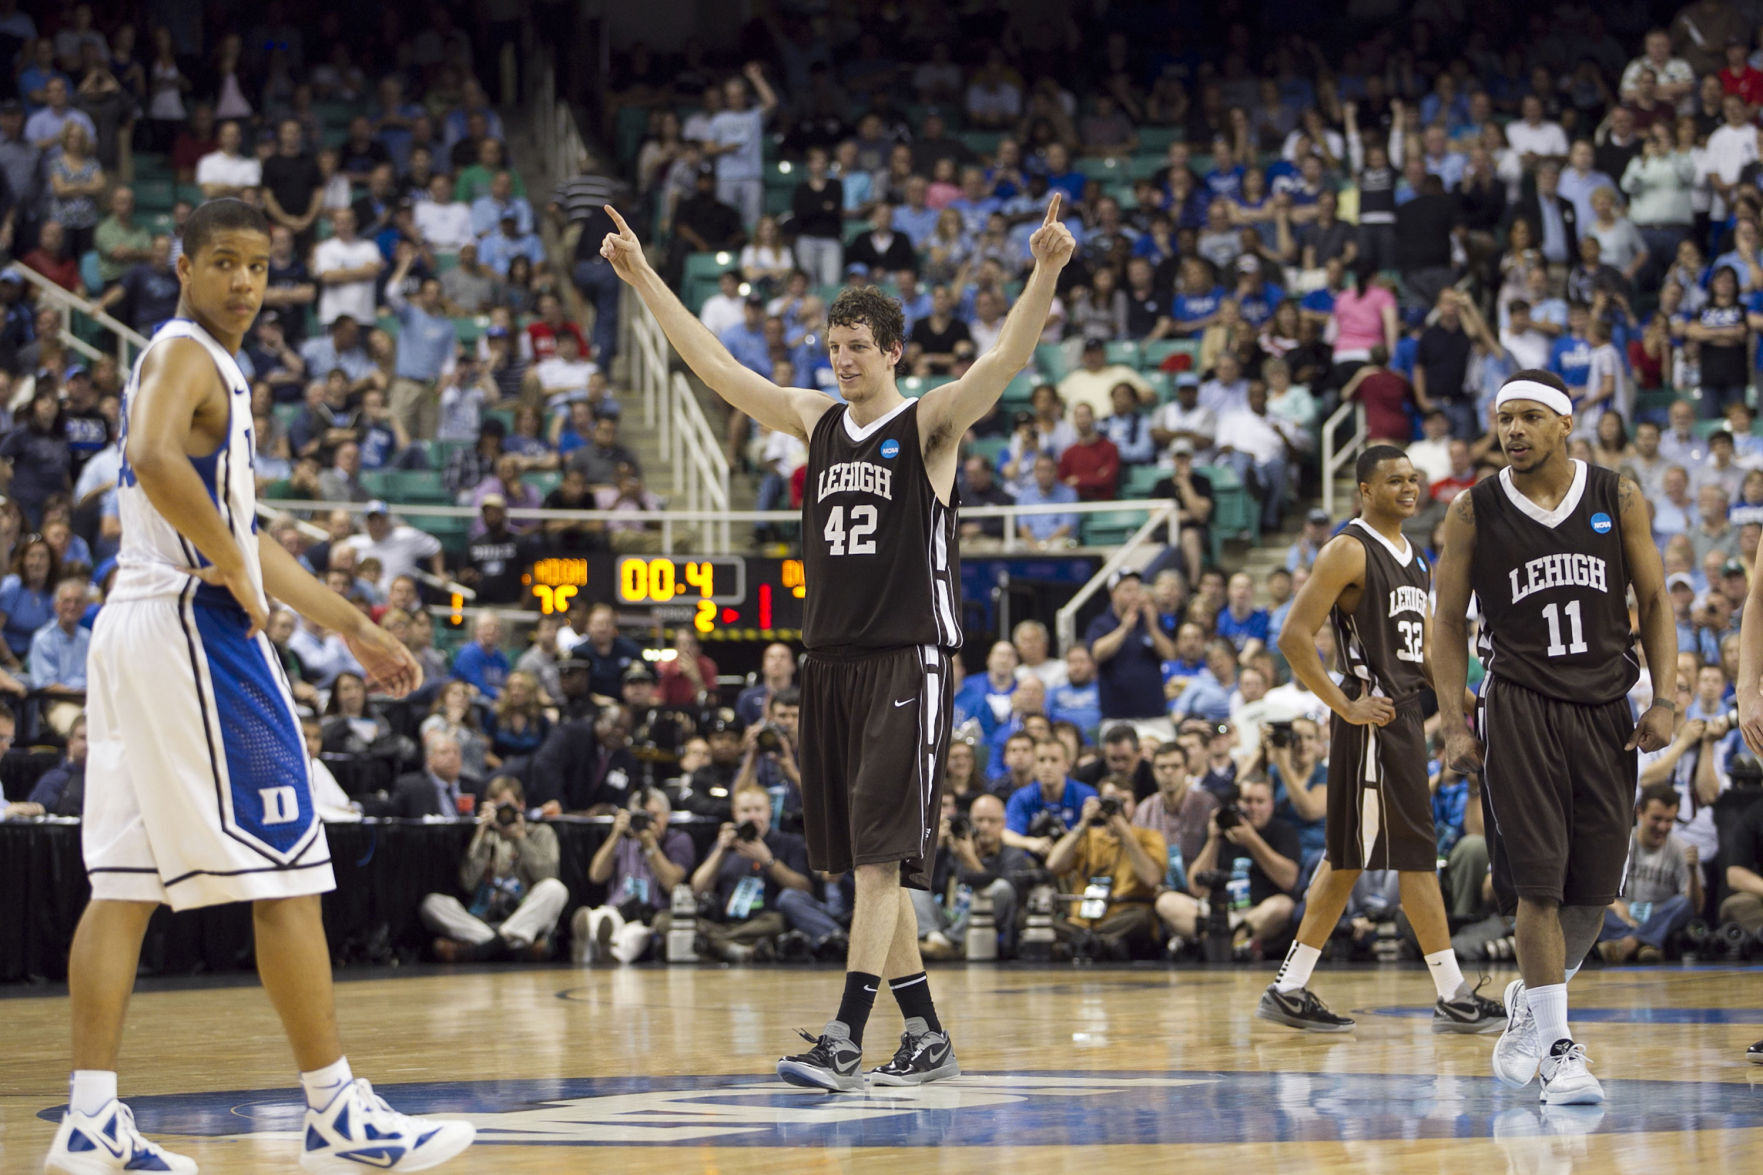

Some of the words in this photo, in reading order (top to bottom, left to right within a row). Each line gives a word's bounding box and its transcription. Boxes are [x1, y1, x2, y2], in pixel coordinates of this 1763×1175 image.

[817, 460, 893, 504] LEHIGH
[823, 504, 878, 556] 42
[1508, 552, 1608, 605] LEHIGH
[694, 599, 717, 633] 2
[1541, 599, 1588, 657] 11
[1396, 620, 1424, 664] 32
[258, 785, 300, 825] D
